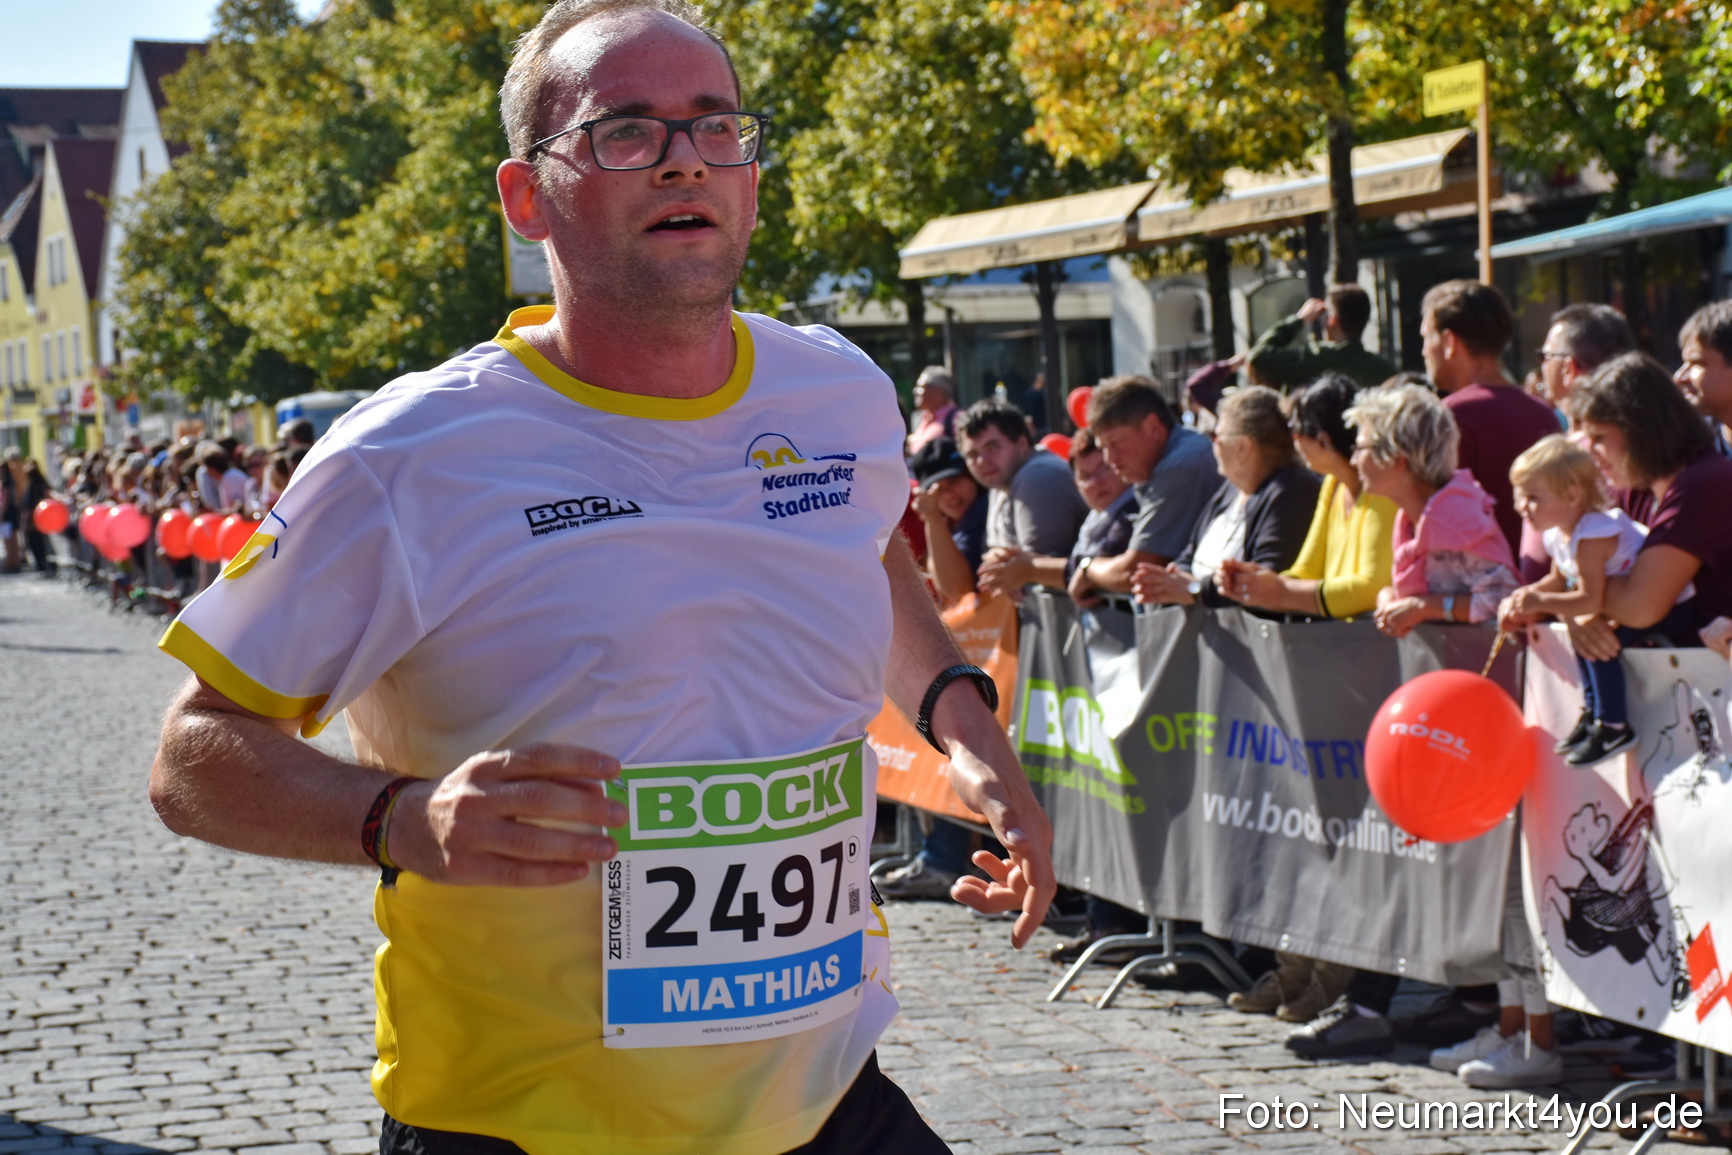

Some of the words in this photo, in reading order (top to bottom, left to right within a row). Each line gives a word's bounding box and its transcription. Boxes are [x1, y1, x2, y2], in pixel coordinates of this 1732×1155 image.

[762, 465, 855, 493] Neumarkter
[524, 496, 642, 528] BOCK
[763, 487, 855, 520] Stadtlauf
[531, 521, 567, 537] inspired
[569, 519, 580, 528] by
[629, 753, 849, 840] BOCK
[848, 842, 857, 857] D
[645, 841, 844, 948] 2497
[662, 953, 841, 1013] MATHIAS
